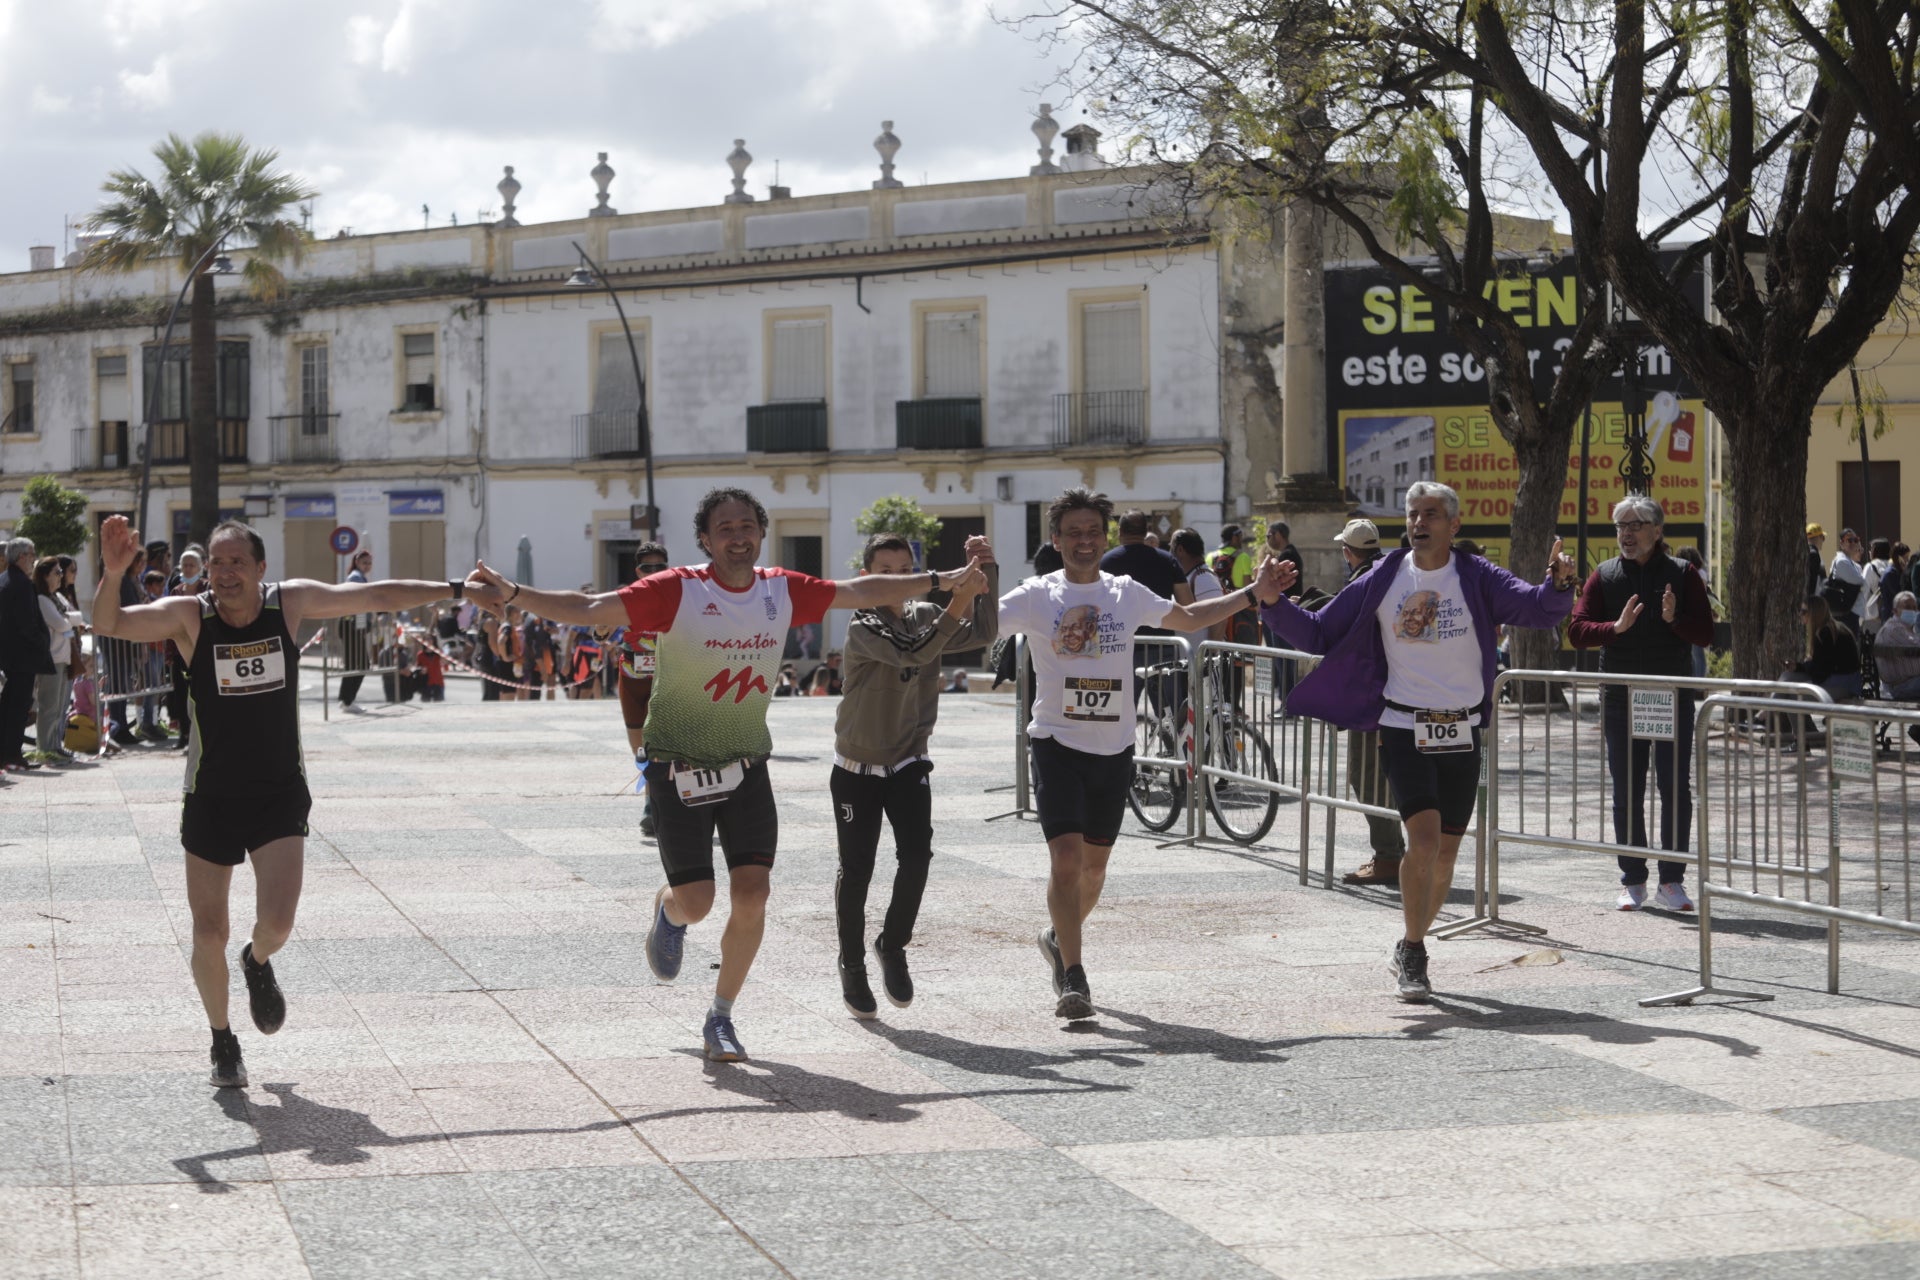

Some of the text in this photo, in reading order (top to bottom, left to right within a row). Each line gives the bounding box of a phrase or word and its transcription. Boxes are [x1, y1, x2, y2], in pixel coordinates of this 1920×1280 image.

[1362, 285, 1435, 335] SE
[1342, 346, 1427, 386] este
[1443, 415, 1490, 449] SE
[1444, 453, 1520, 472] Edifici
[1466, 478, 1520, 491] Mueble
[1660, 475, 1698, 488] Silos
[1436, 598, 1452, 608] LOS
[1096, 613, 1114, 623] LOS
[1436, 607, 1463, 619] NIÑOS
[1096, 621, 1125, 633] NIÑOS
[1437, 619, 1456, 630] DEL
[704, 632, 778, 649] maratón
[1100, 634, 1119, 644] DEL
[233, 643, 266, 655] Sherry
[235, 657, 266, 678] 68
[1075, 690, 1111, 708] 107
[1633, 692, 1672, 706] ALQUIVALLE
[1426, 723, 1459, 740] 106
[1633, 722, 1673, 734] 956 34 05 96
[692, 769, 723, 788] 111
